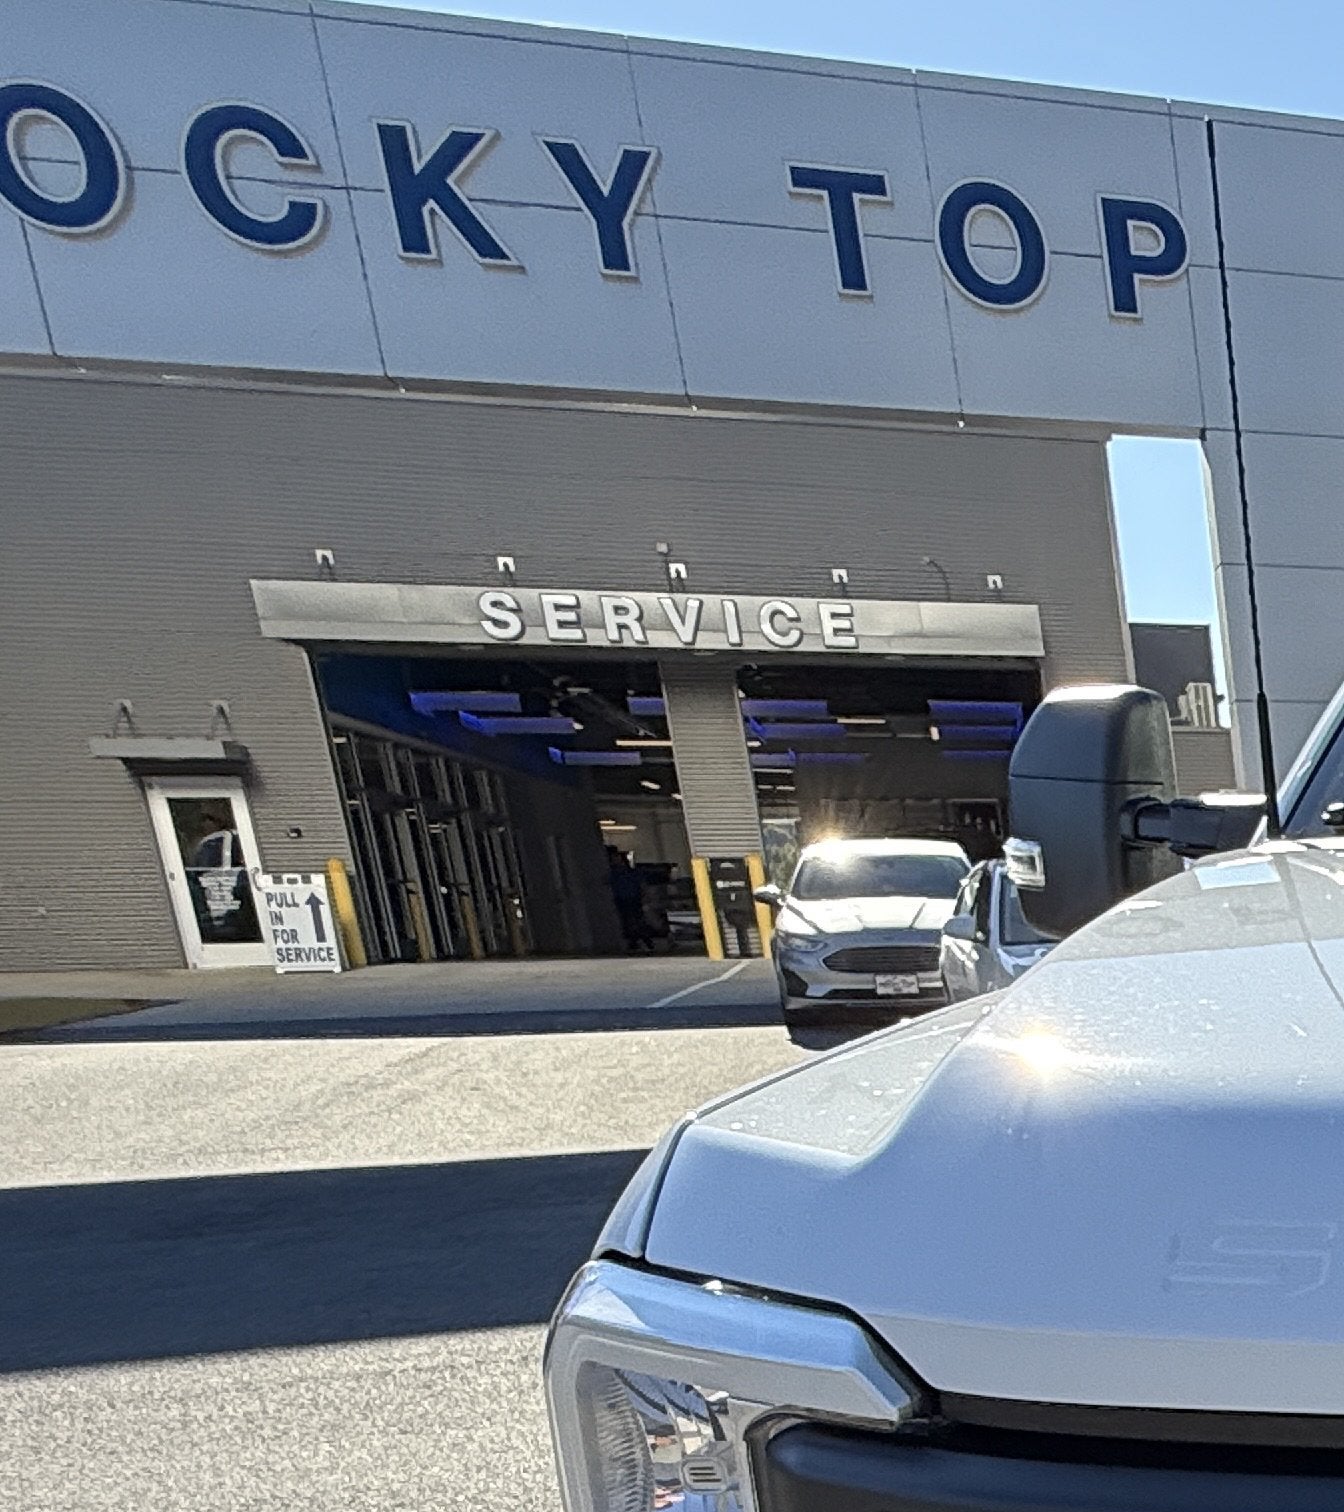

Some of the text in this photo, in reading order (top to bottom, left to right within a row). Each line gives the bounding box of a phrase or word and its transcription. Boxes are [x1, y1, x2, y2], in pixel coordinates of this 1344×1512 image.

[0, 79, 1190, 320] OCKY TOP
[478, 590, 859, 649] SERVICE
[265, 892, 300, 908] PULL
[269, 911, 284, 926] IN
[272, 929, 300, 945] FOR
[276, 947, 336, 963] SERVICE
